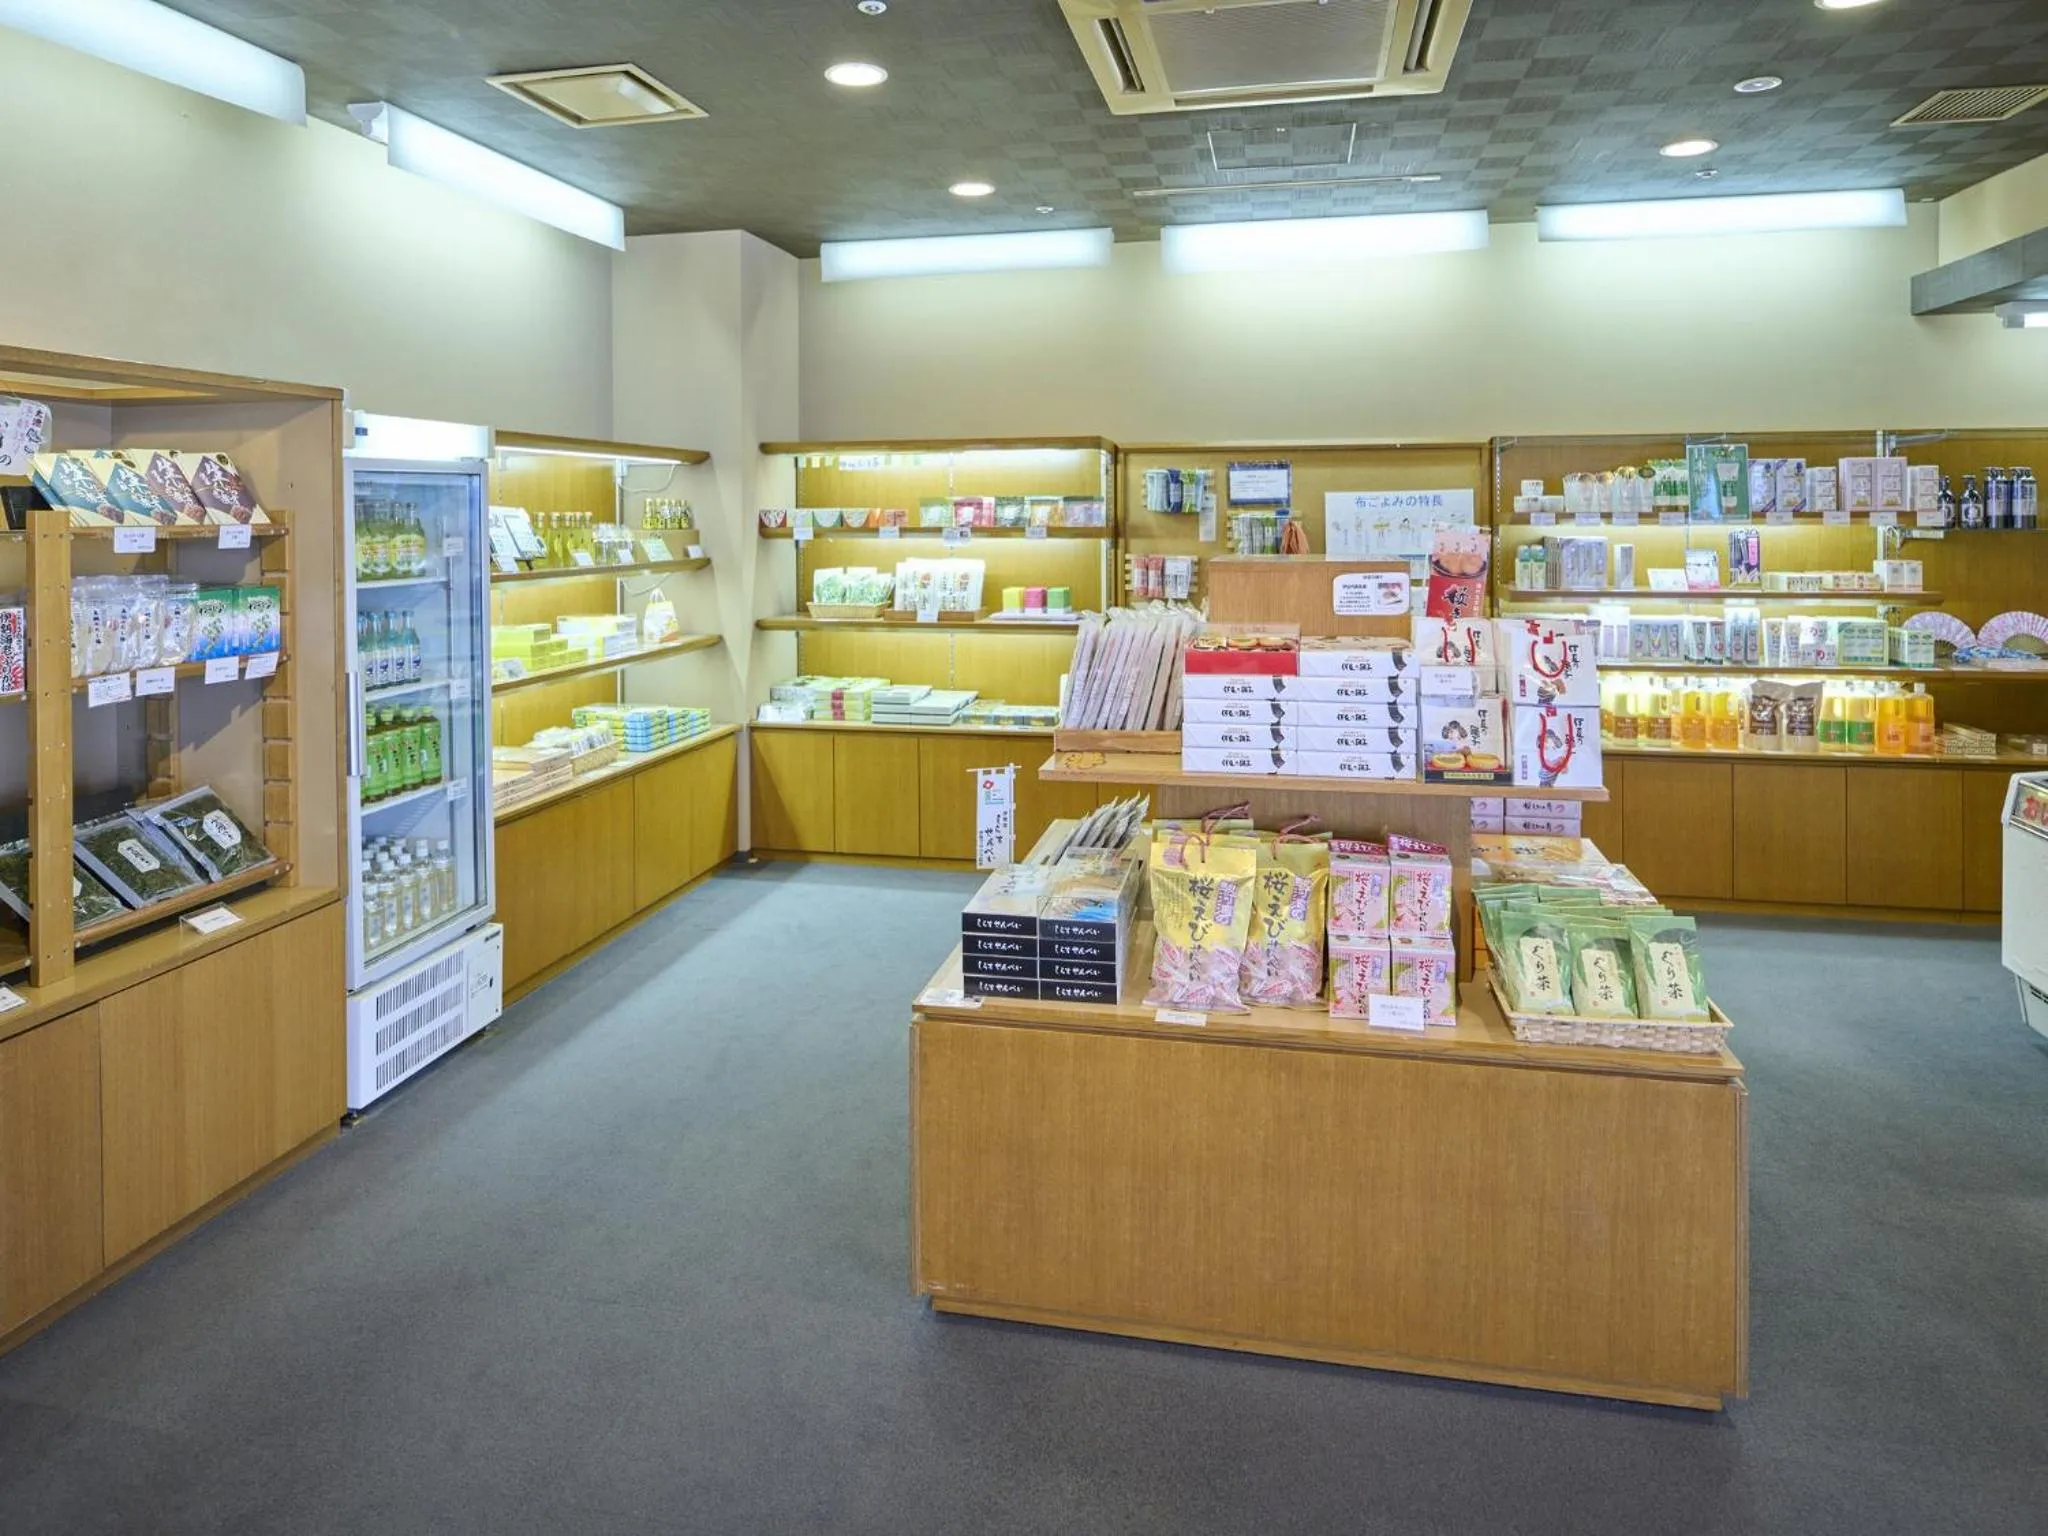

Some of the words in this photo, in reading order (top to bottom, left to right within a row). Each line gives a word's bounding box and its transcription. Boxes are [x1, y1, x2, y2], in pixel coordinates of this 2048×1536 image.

[1530, 944, 1552, 992] ぐり茶
[1592, 955, 1615, 1001] ぐり茶
[1660, 950, 1684, 1000] ぐり茶
